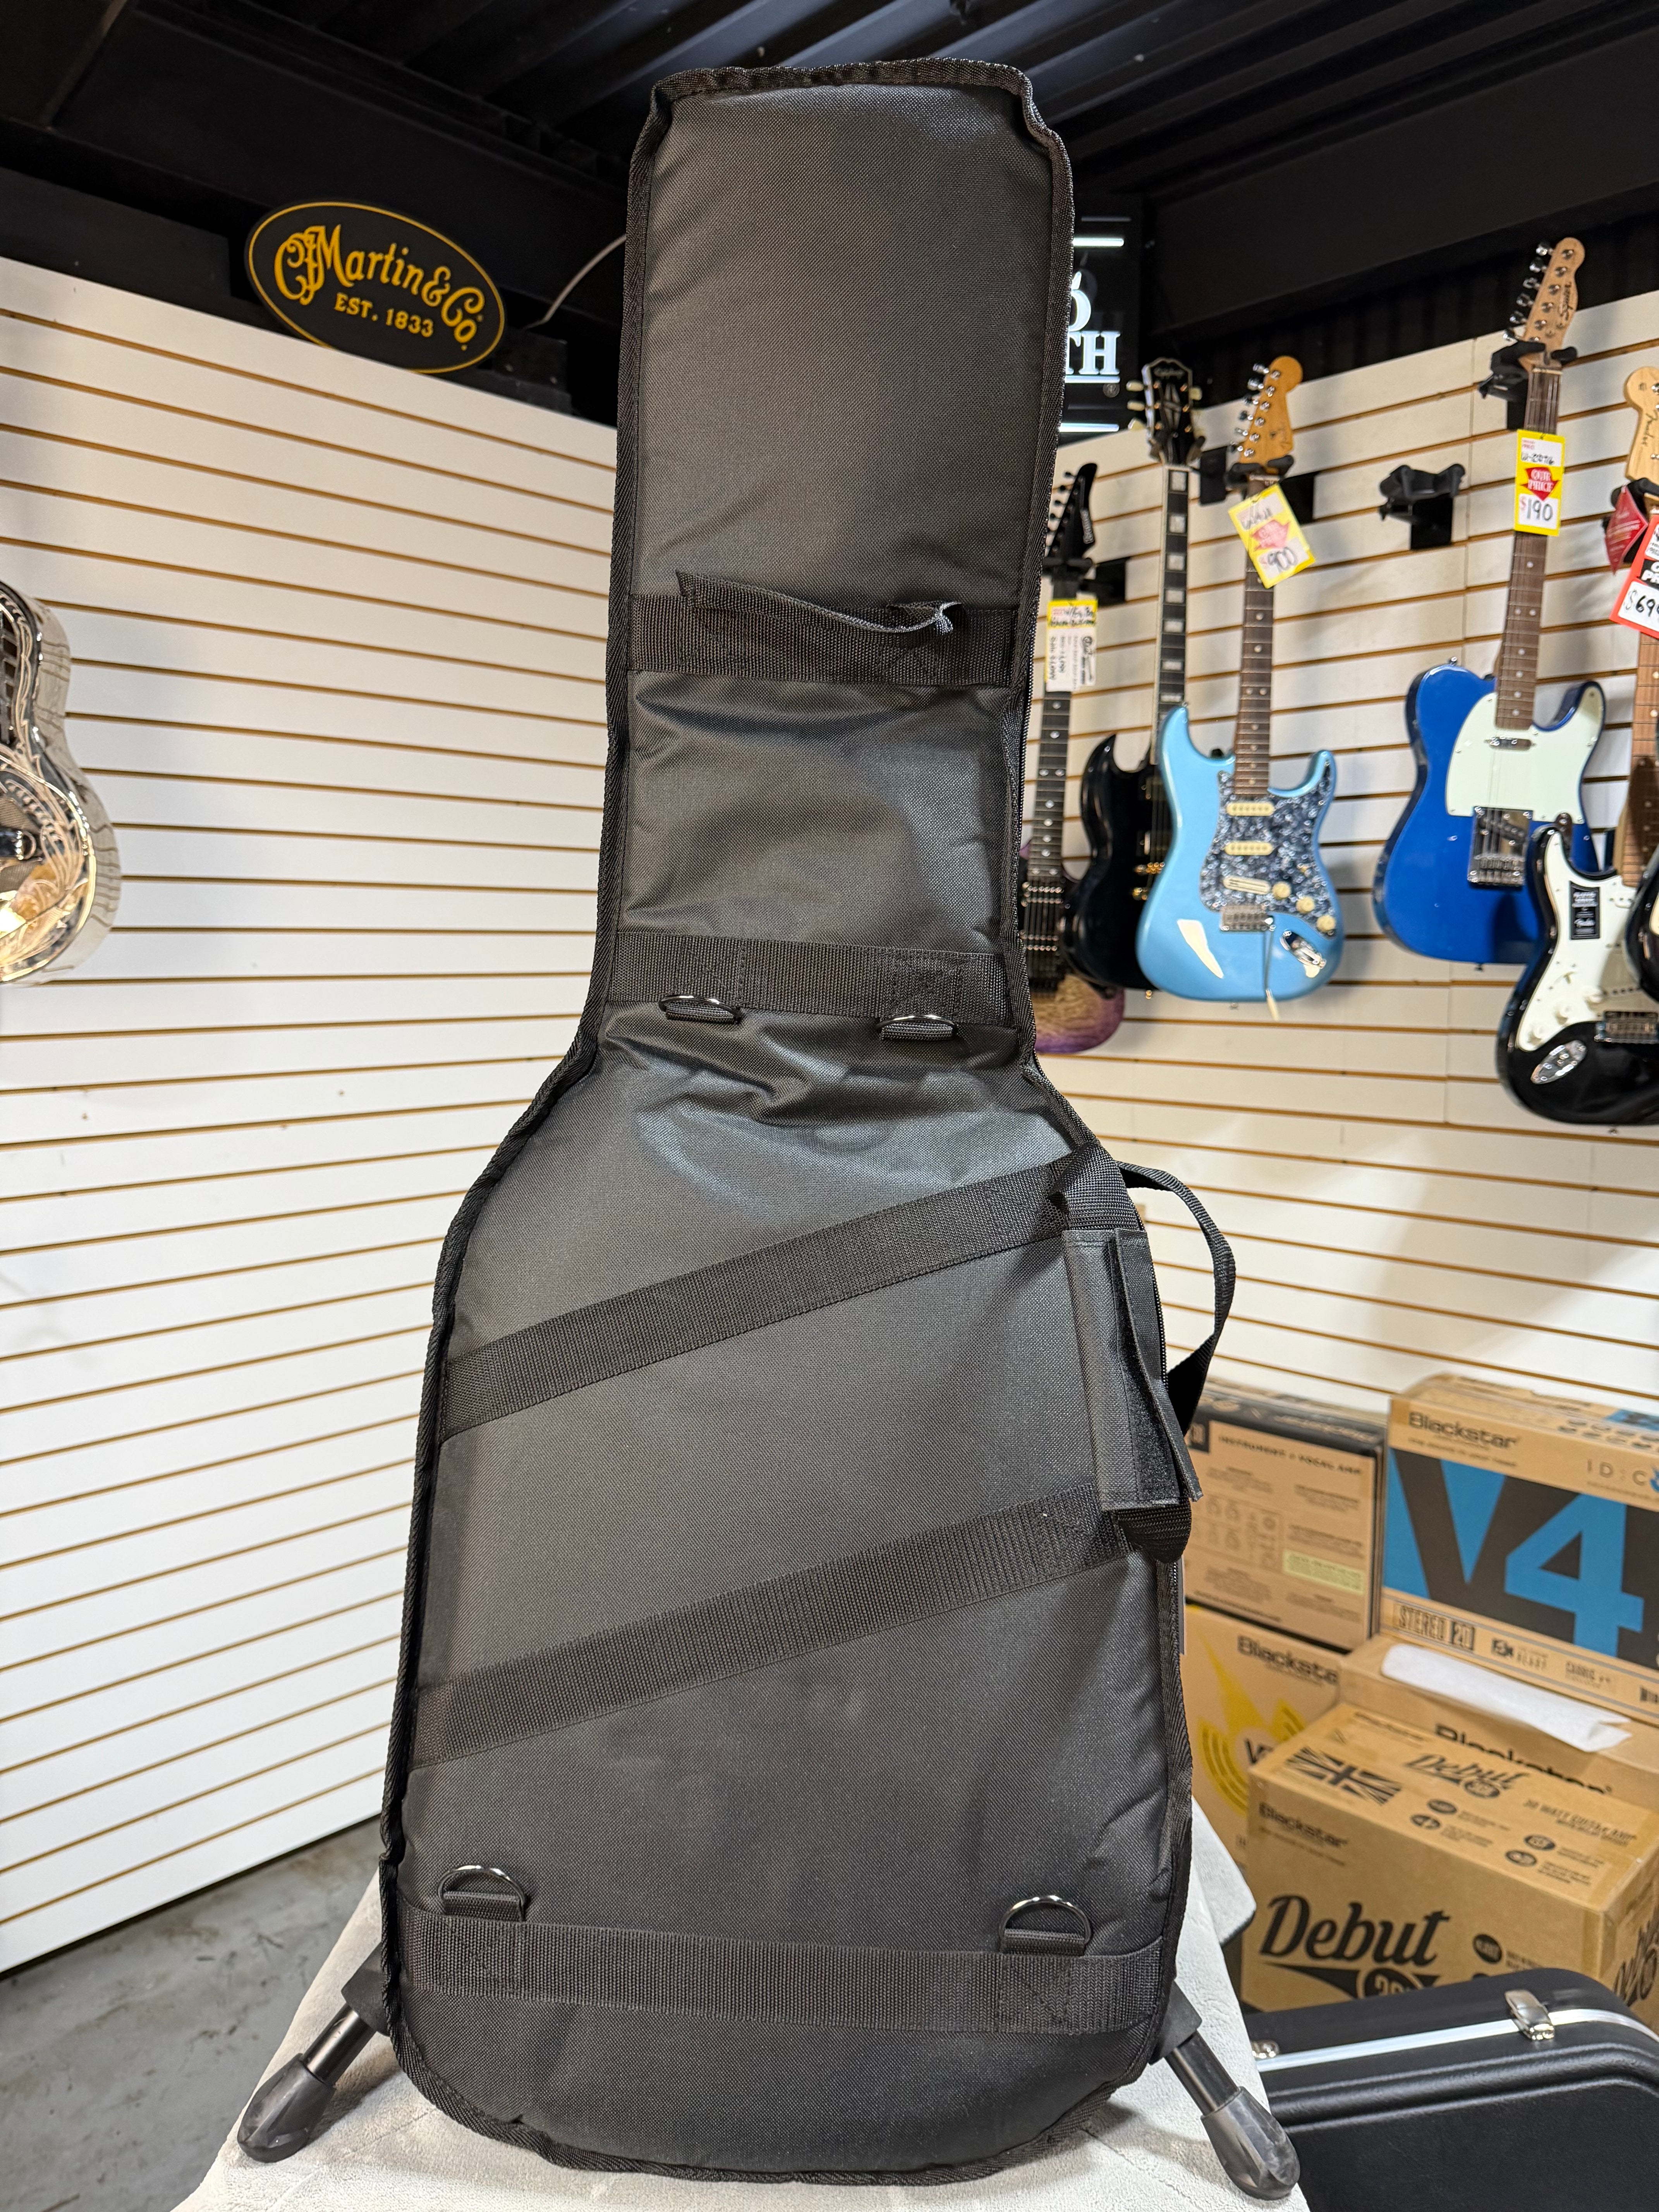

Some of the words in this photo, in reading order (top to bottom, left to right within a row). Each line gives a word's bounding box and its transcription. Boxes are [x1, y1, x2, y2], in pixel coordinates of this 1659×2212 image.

[334, 293, 378, 321] EST.
[386, 309, 434, 337] 1833
[1408, 1411, 1518, 1448] Blackstar
[1399, 1605, 1448, 1640] STEREO
[1238, 1635, 1338, 1685] Blacksta
[1259, 1802, 1348, 1848] Blackstar
[1260, 1894, 1451, 1967] Debut
